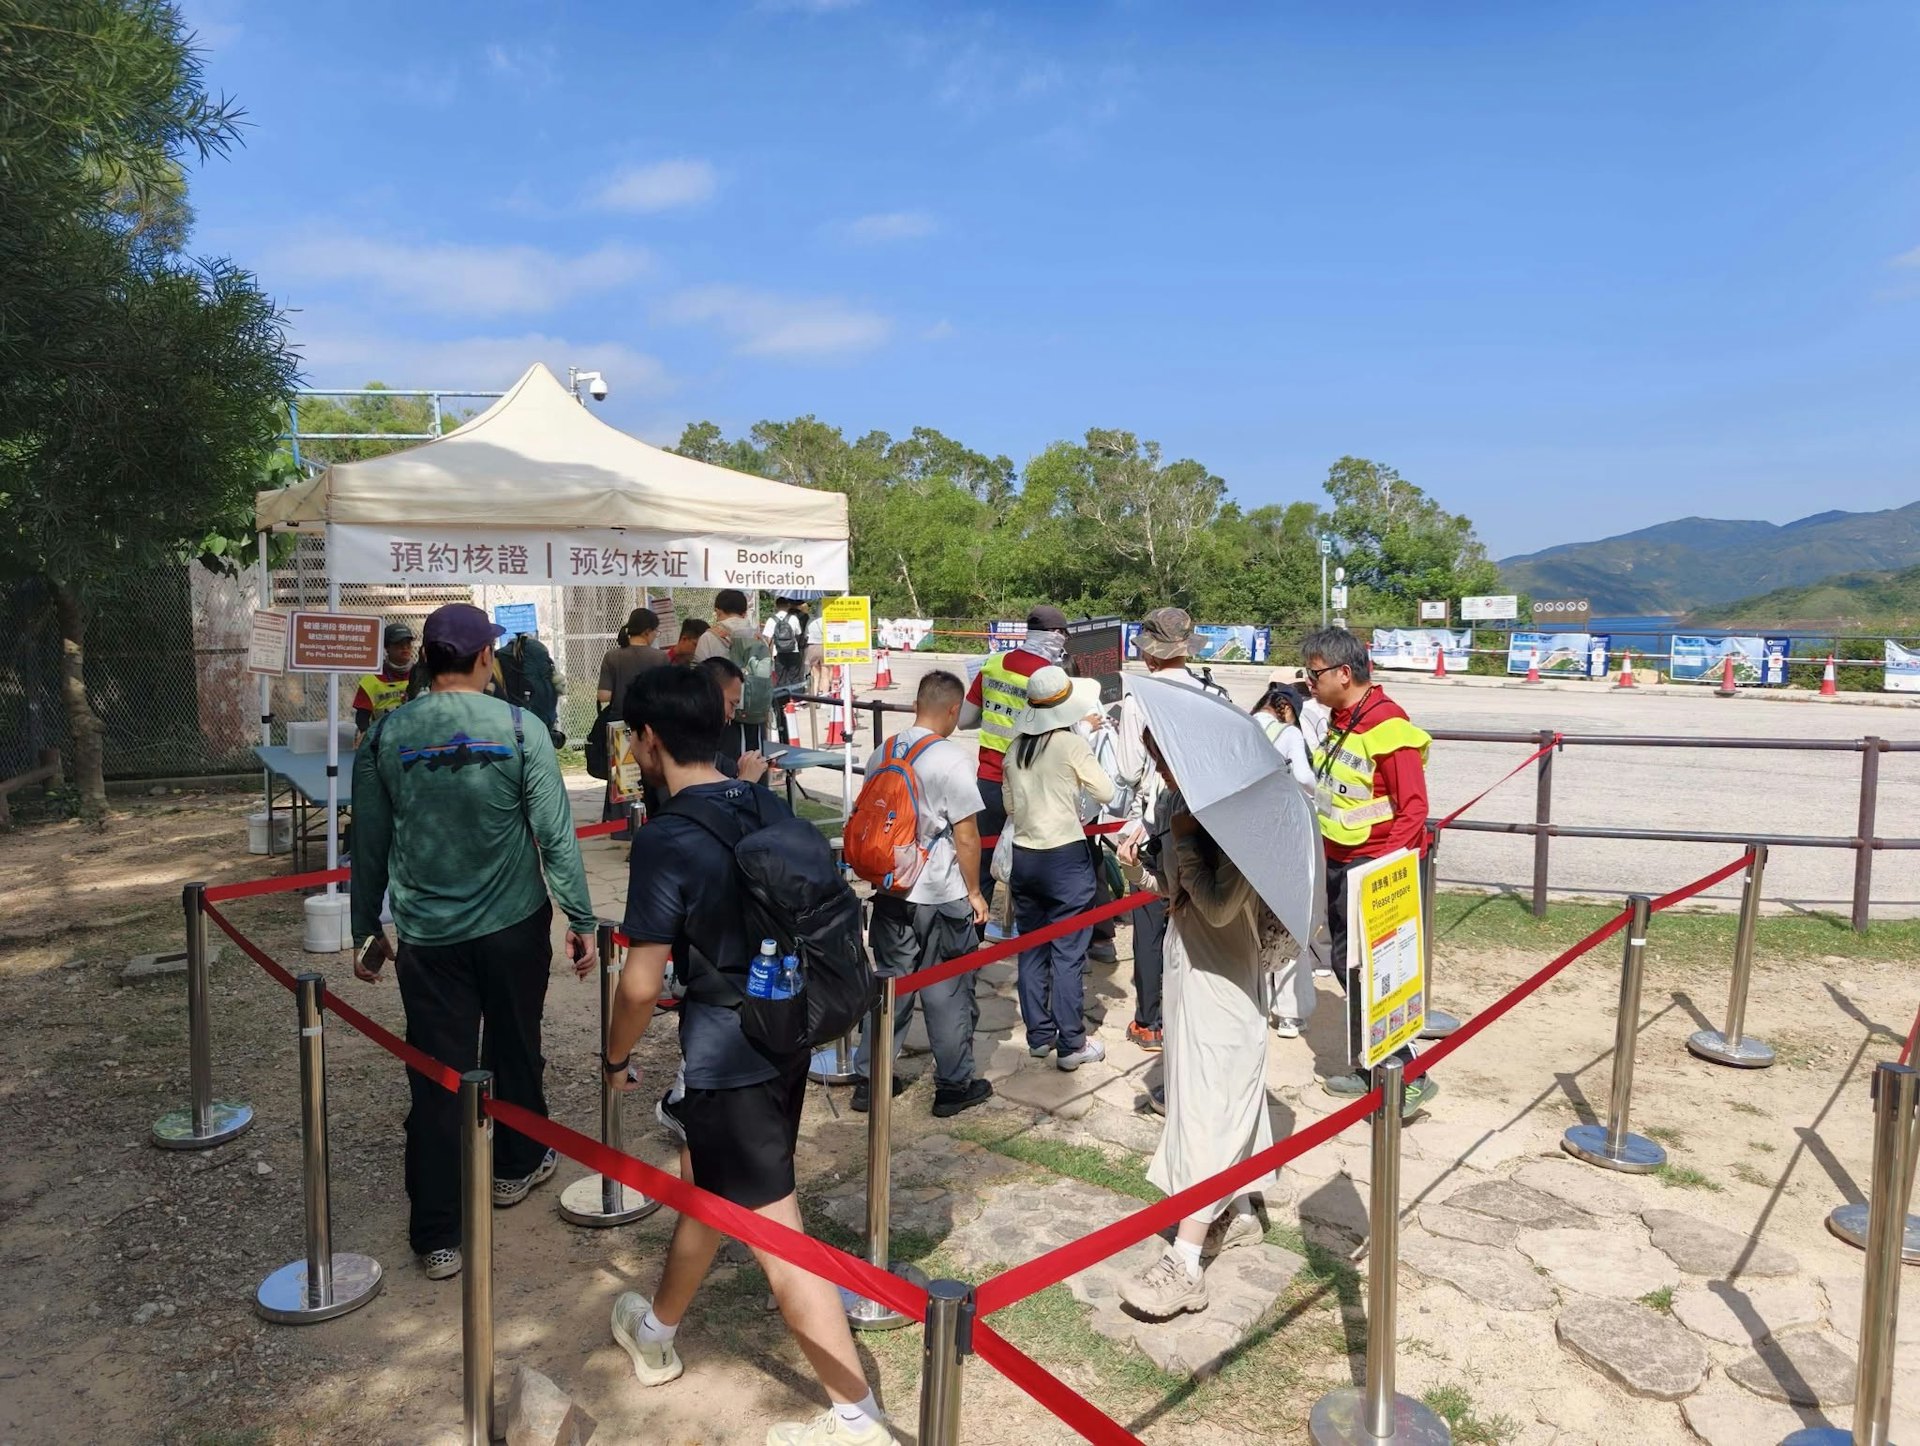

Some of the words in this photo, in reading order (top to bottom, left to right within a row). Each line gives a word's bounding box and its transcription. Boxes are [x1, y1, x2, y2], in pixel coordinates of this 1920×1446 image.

[390, 541, 529, 575] 預約核證
[570, 546, 688, 578] 预约核证
[737, 549, 803, 568] Booking
[724, 569, 815, 585] Verification
[300, 643, 326, 651] Booking
[1372, 895, 1391, 911] Please
[1390, 884, 1411, 903] prepare
